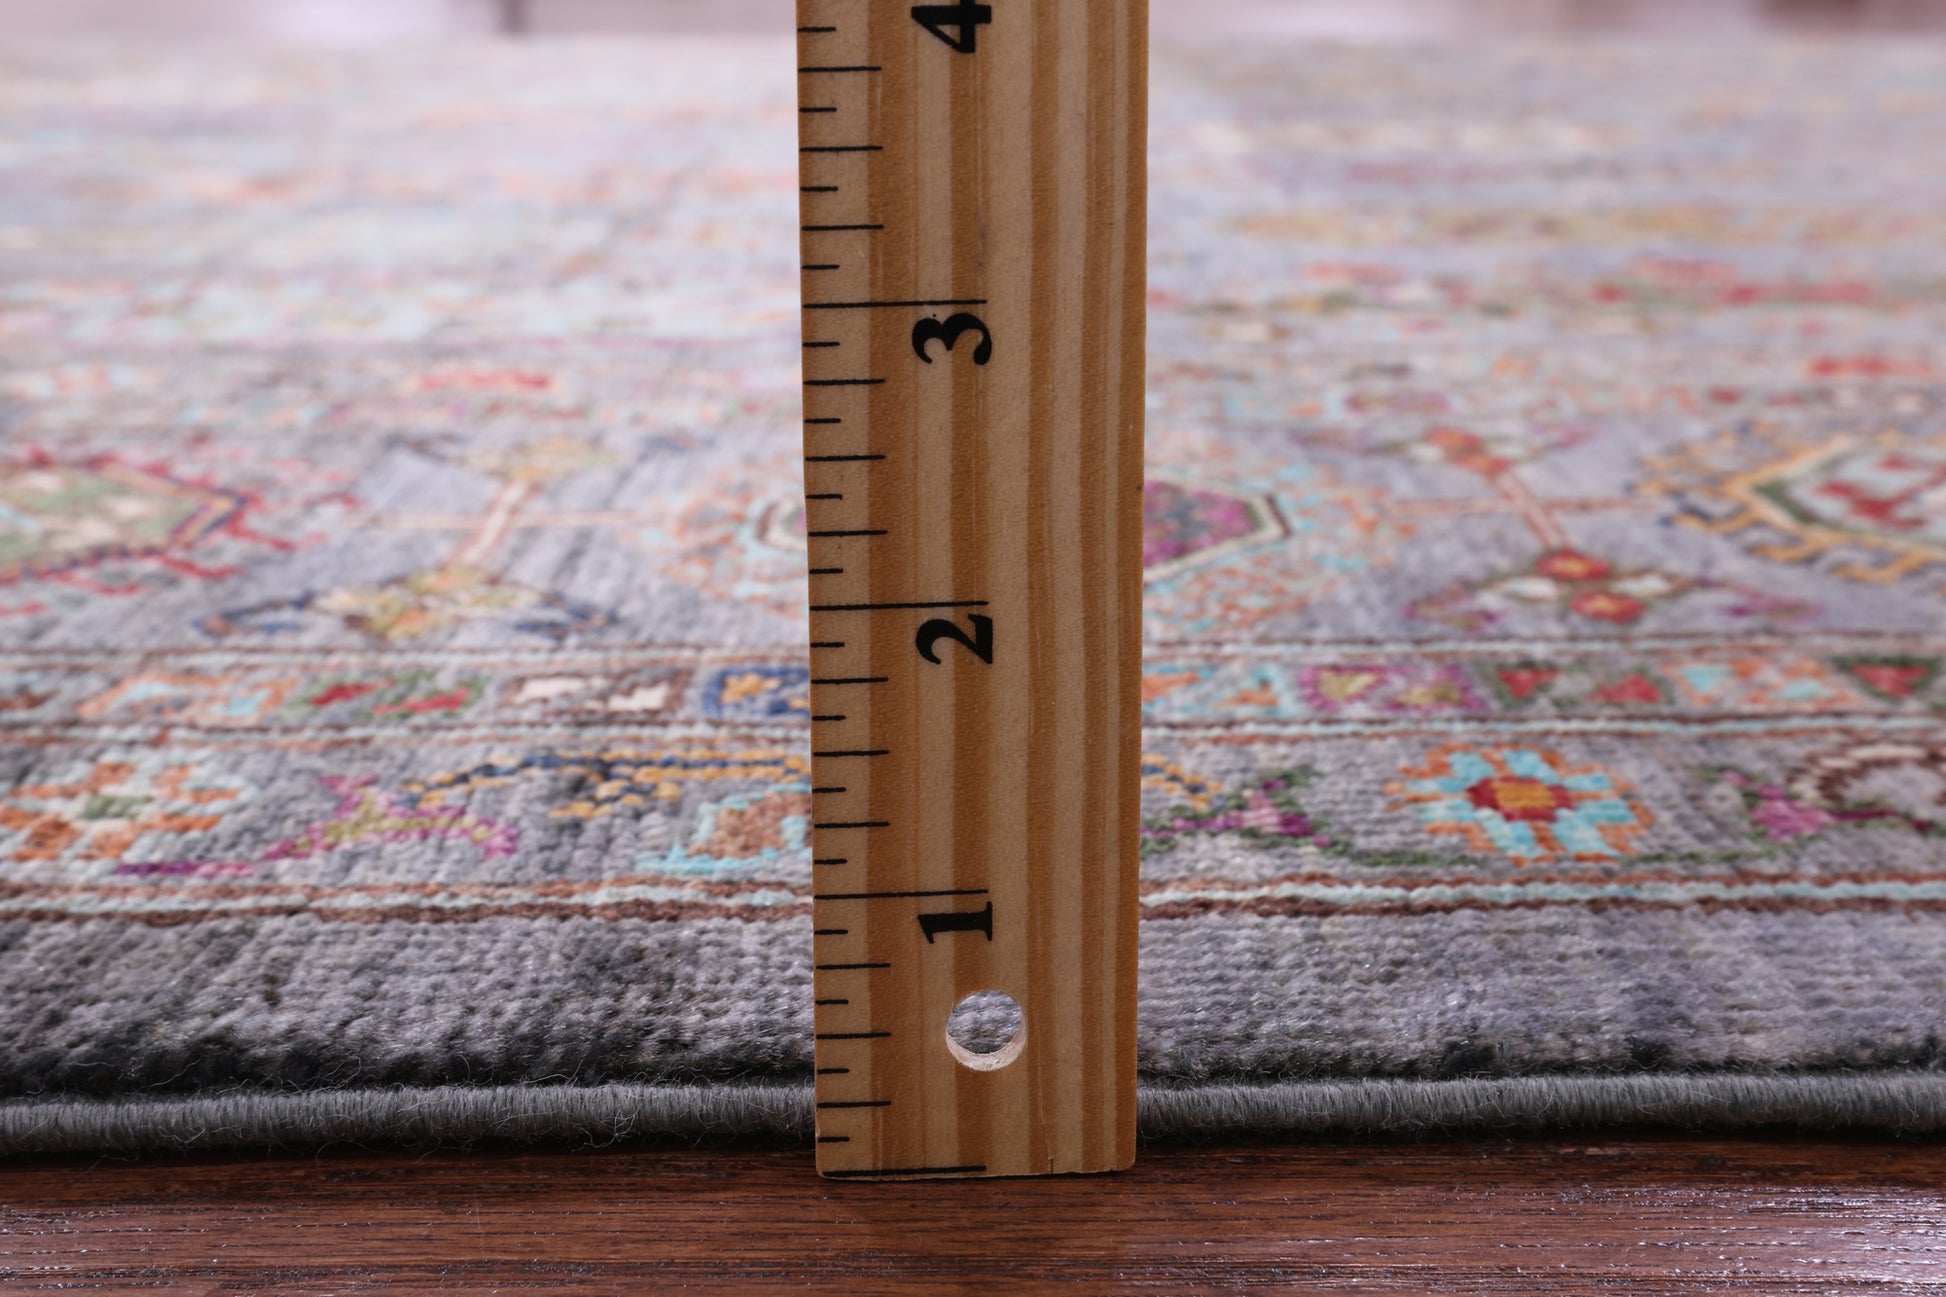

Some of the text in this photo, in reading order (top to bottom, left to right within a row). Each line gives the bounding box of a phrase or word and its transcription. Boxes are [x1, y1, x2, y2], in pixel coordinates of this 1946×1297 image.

[911, 0, 992, 54] 4
[911, 312, 992, 366] 3
[915, 612, 993, 665] 2
[916, 901, 993, 944] 1
